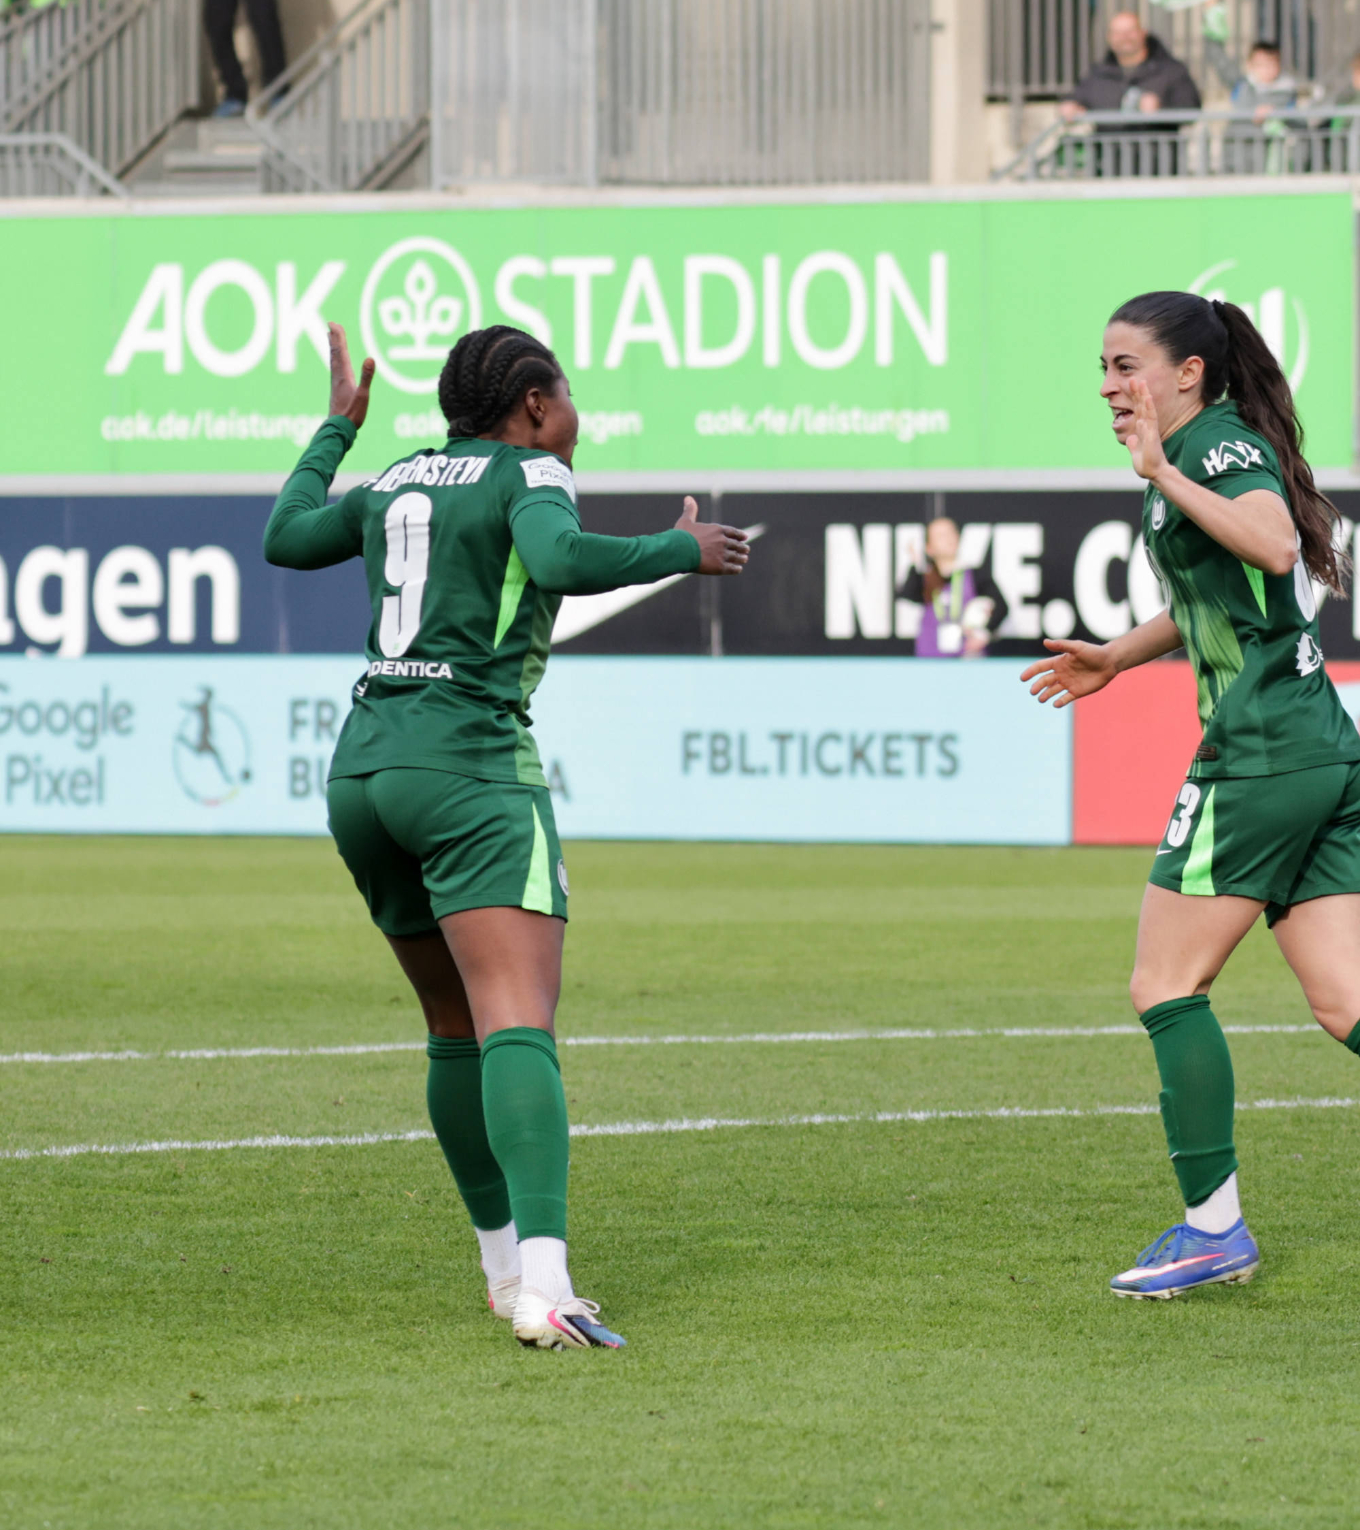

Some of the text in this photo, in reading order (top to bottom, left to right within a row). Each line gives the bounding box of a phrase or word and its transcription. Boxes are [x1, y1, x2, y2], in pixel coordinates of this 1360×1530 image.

[105, 252, 948, 376] AOK STADION
[101, 408, 330, 448] aok.de/leistung
[1202, 440, 1263, 476] HAIX
[378, 491, 432, 658] 9
[0, 544, 241, 659] gen
[6, 753, 106, 805] Pixel
[680, 731, 960, 777] FBL.TICKETS
